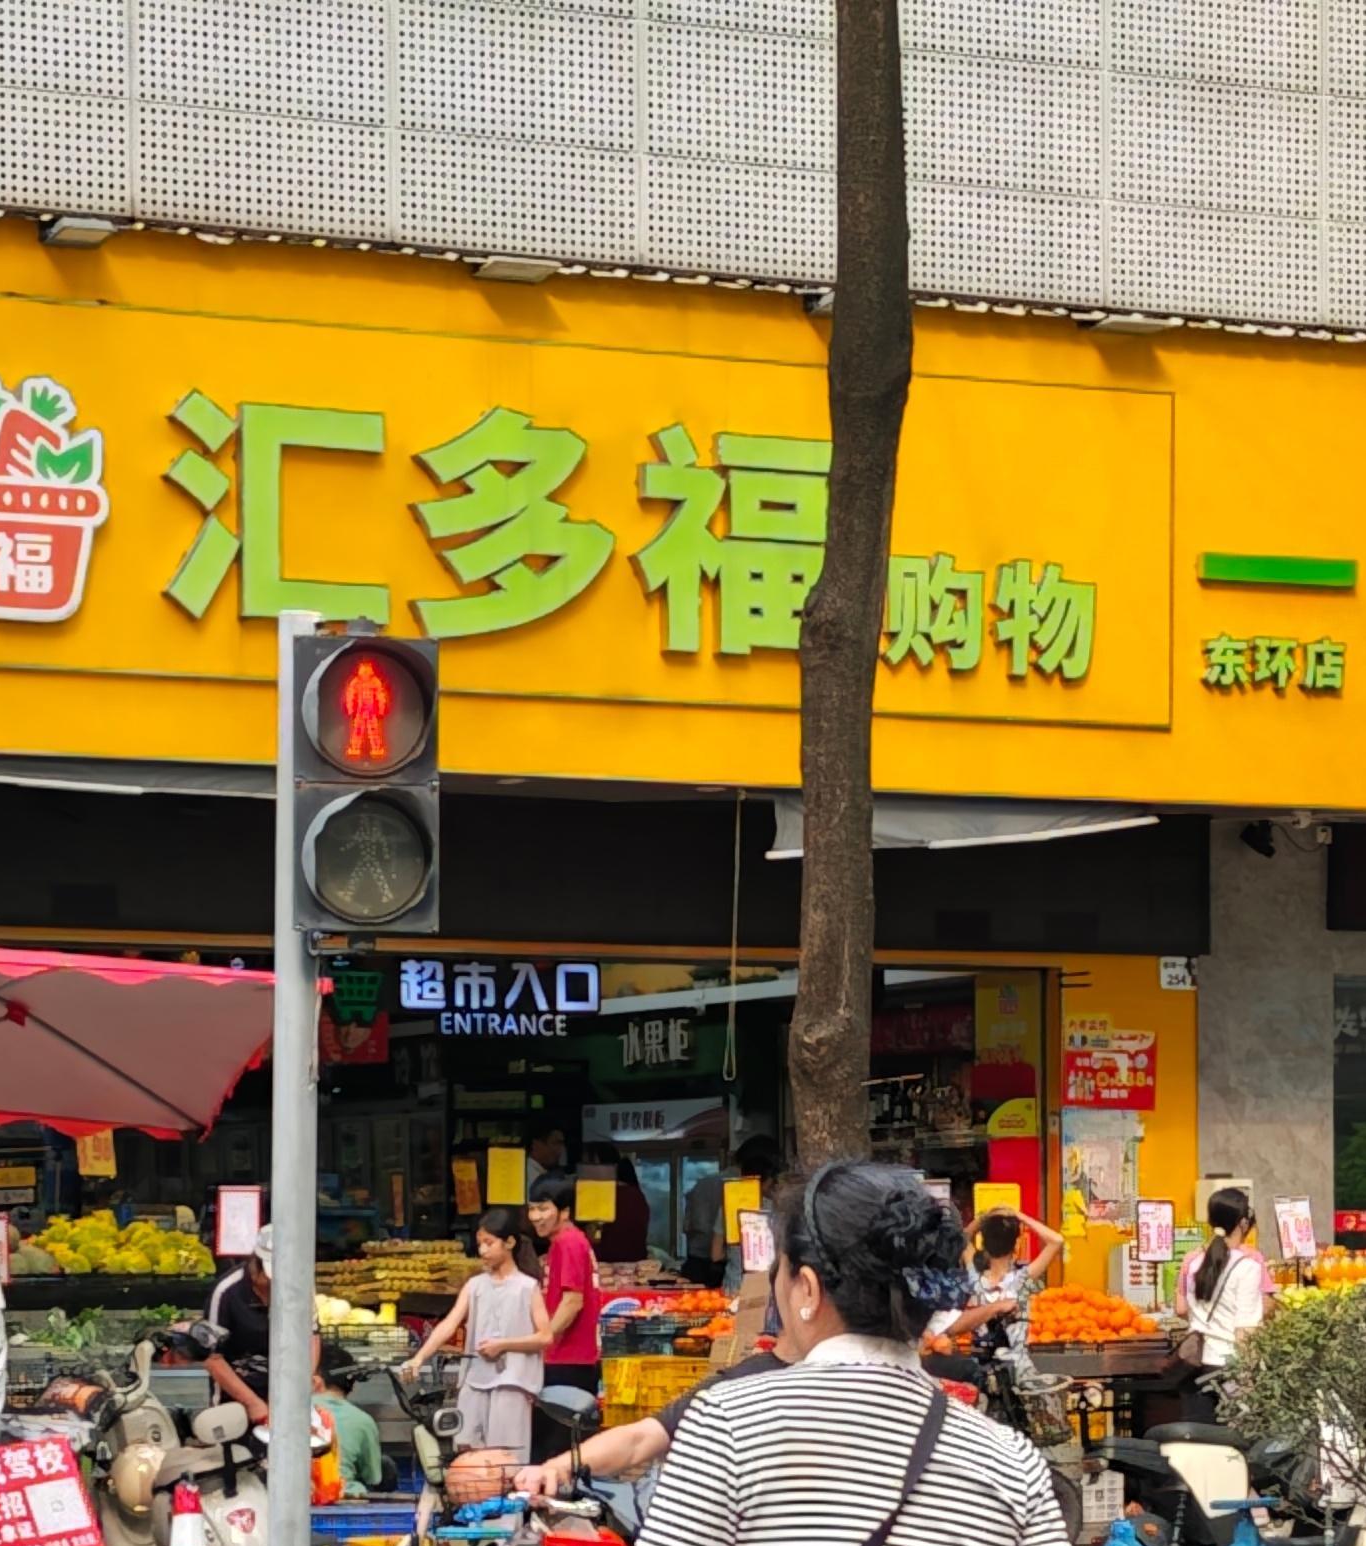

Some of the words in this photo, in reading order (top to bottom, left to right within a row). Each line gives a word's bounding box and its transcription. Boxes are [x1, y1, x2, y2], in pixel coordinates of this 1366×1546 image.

[161, 387, 833, 656] 汇多福
[882, 552, 1096, 681] 购物
[1201, 634, 1346, 696] 东环店
[399, 959, 601, 1012] 超市入口
[440, 1012, 568, 1037] ENTRANCE
[617, 1018, 690, 1068] 水果柜
